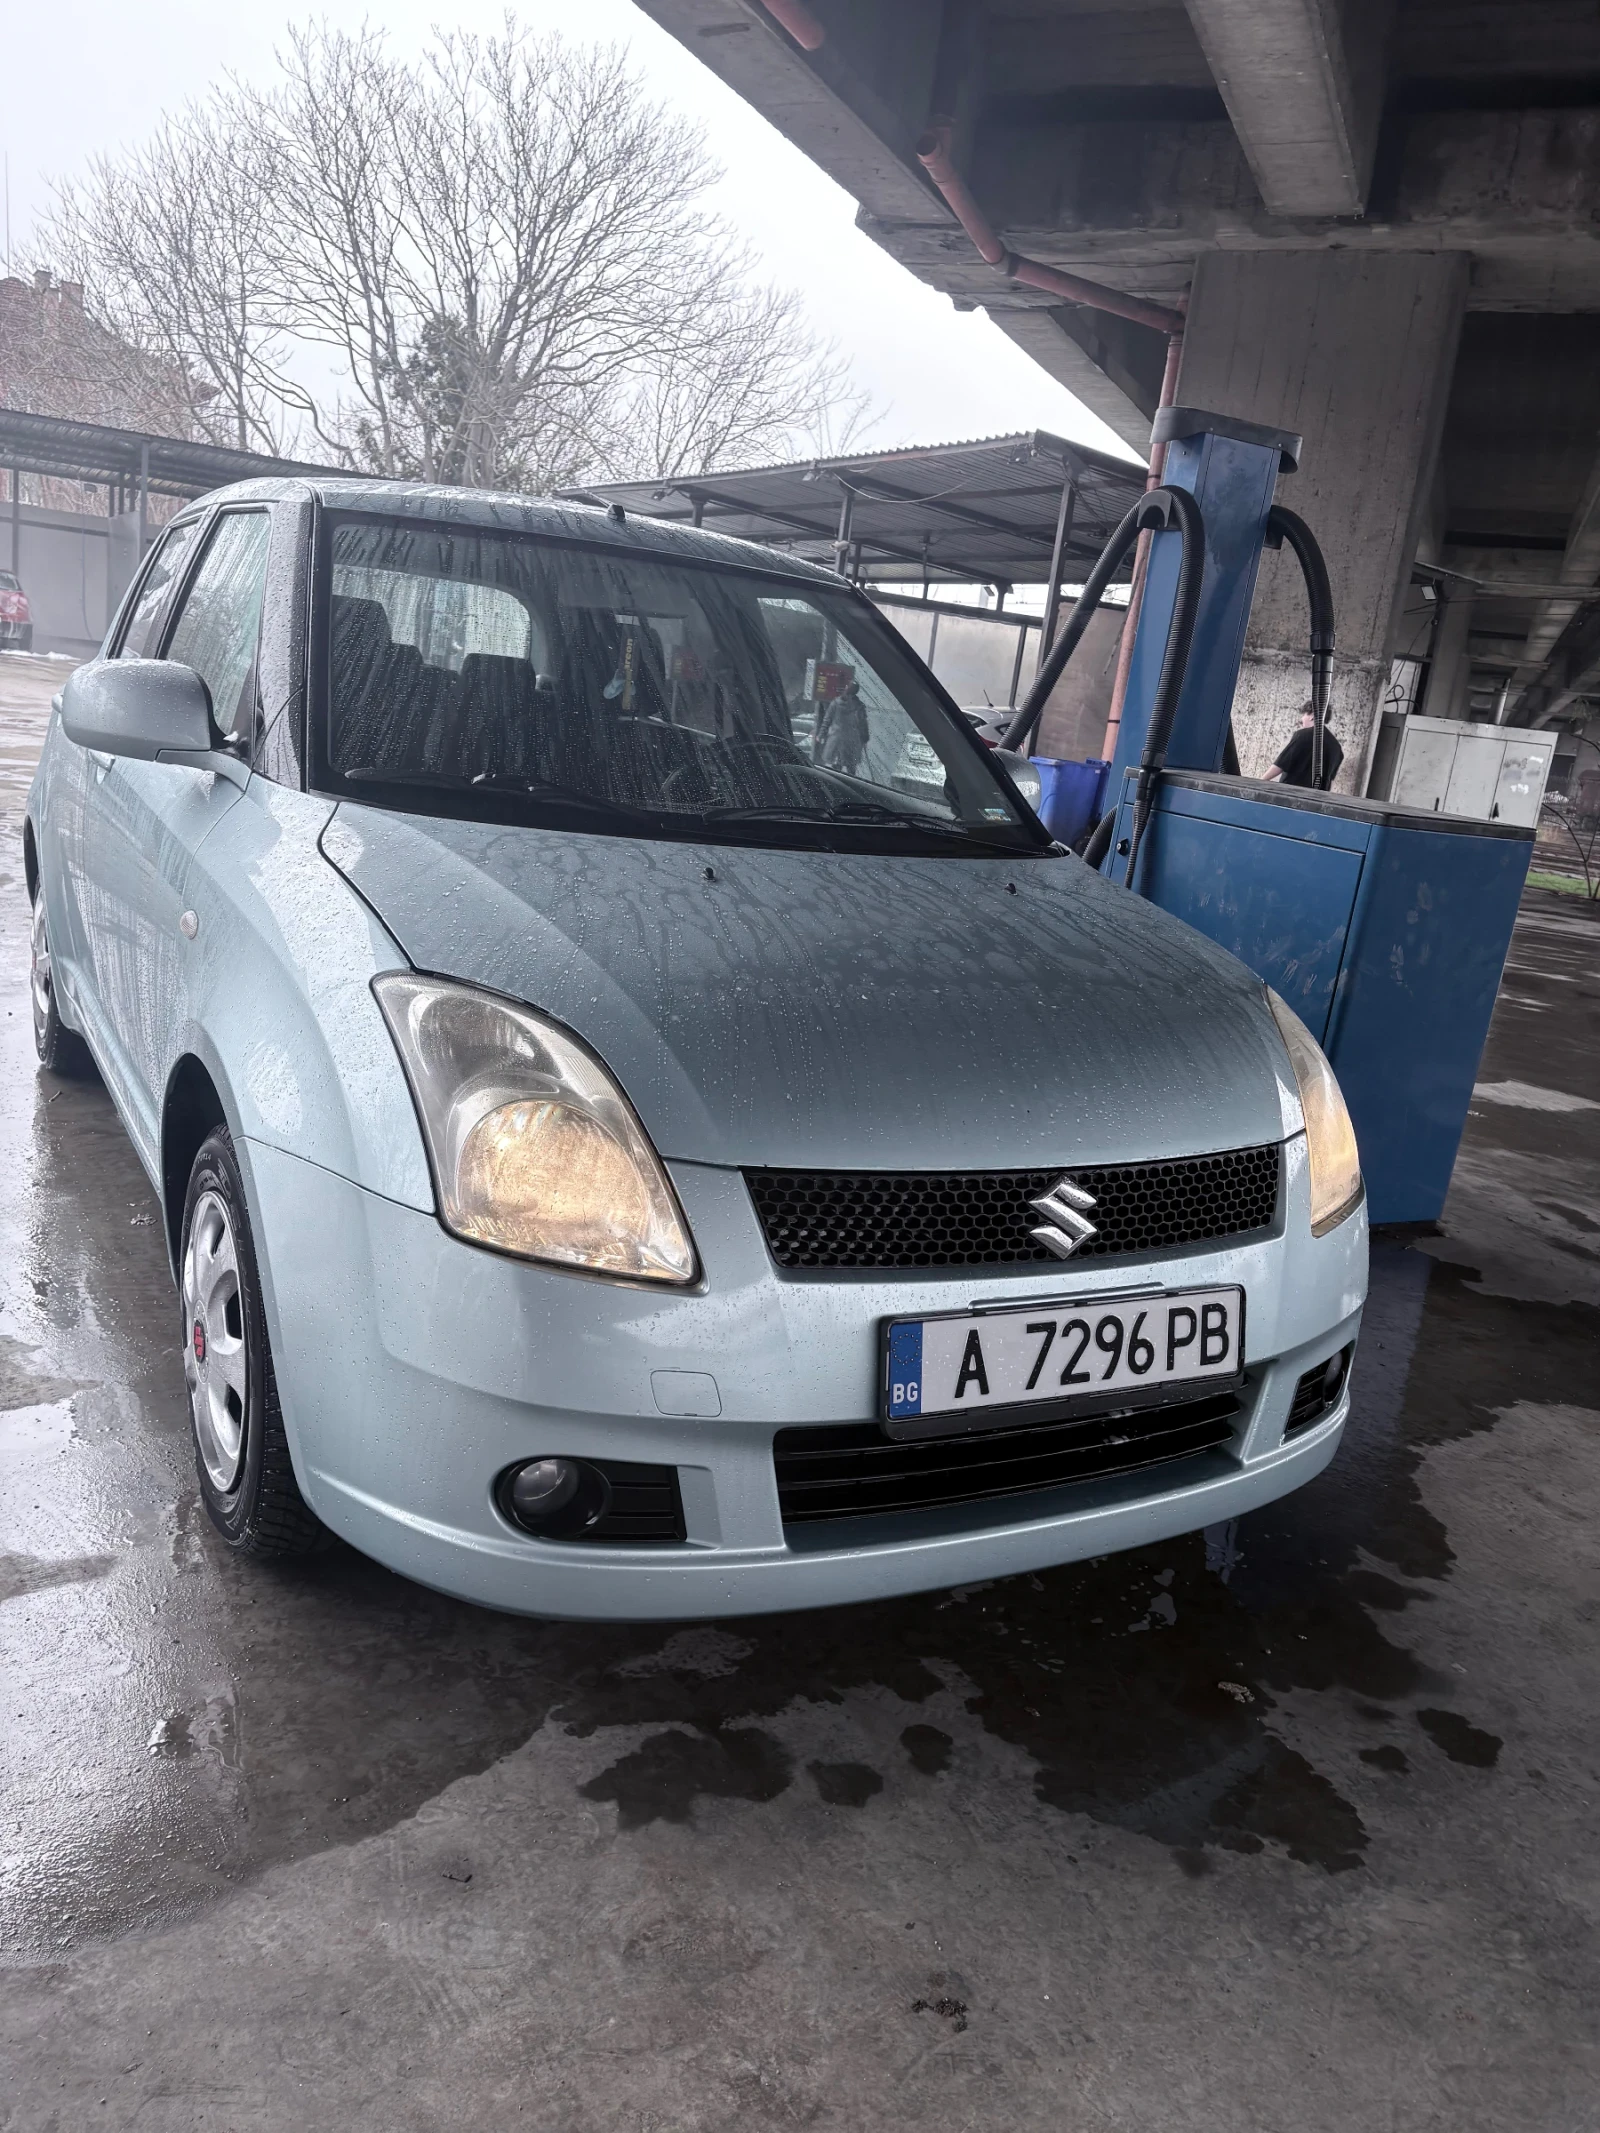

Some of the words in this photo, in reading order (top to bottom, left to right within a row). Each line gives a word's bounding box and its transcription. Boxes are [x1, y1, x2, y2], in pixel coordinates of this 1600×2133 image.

[954, 1329, 990, 1399] A
[1026, 1311, 1155, 1390] 7296
[1166, 1303, 1230, 1371] PB
[893, 1383, 919, 1405] BG
